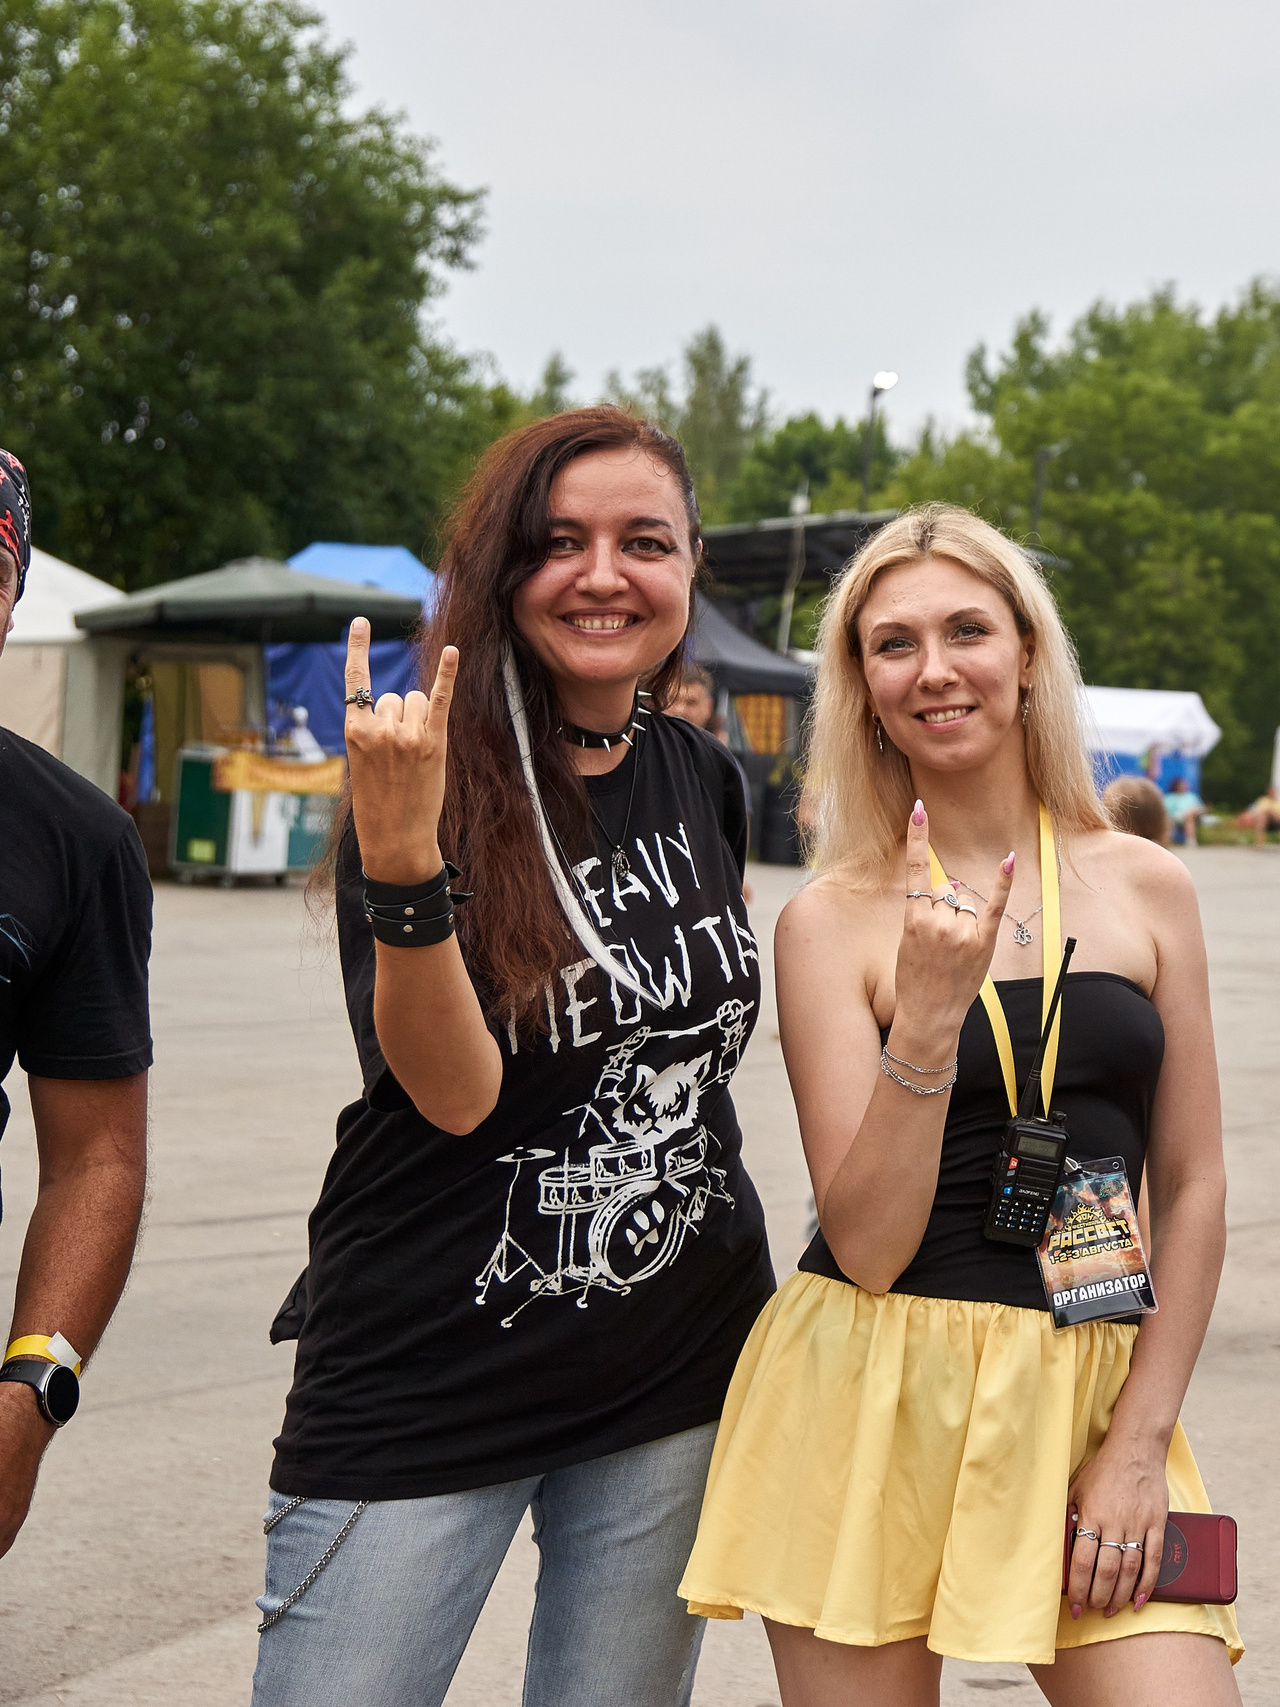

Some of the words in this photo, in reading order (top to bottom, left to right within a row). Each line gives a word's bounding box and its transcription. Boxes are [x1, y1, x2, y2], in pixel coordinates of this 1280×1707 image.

[562, 822, 701, 933] EAVY
[508, 897, 759, 1054] MEOWTA
[1048, 1219, 1130, 1252] РАССВЕТ
[1050, 1249, 1080, 1264] 1-2-3
[1082, 1239, 1133, 1257] АВГУСТА
[1053, 1273, 1146, 1306] ОРГАНИЗАТОР
